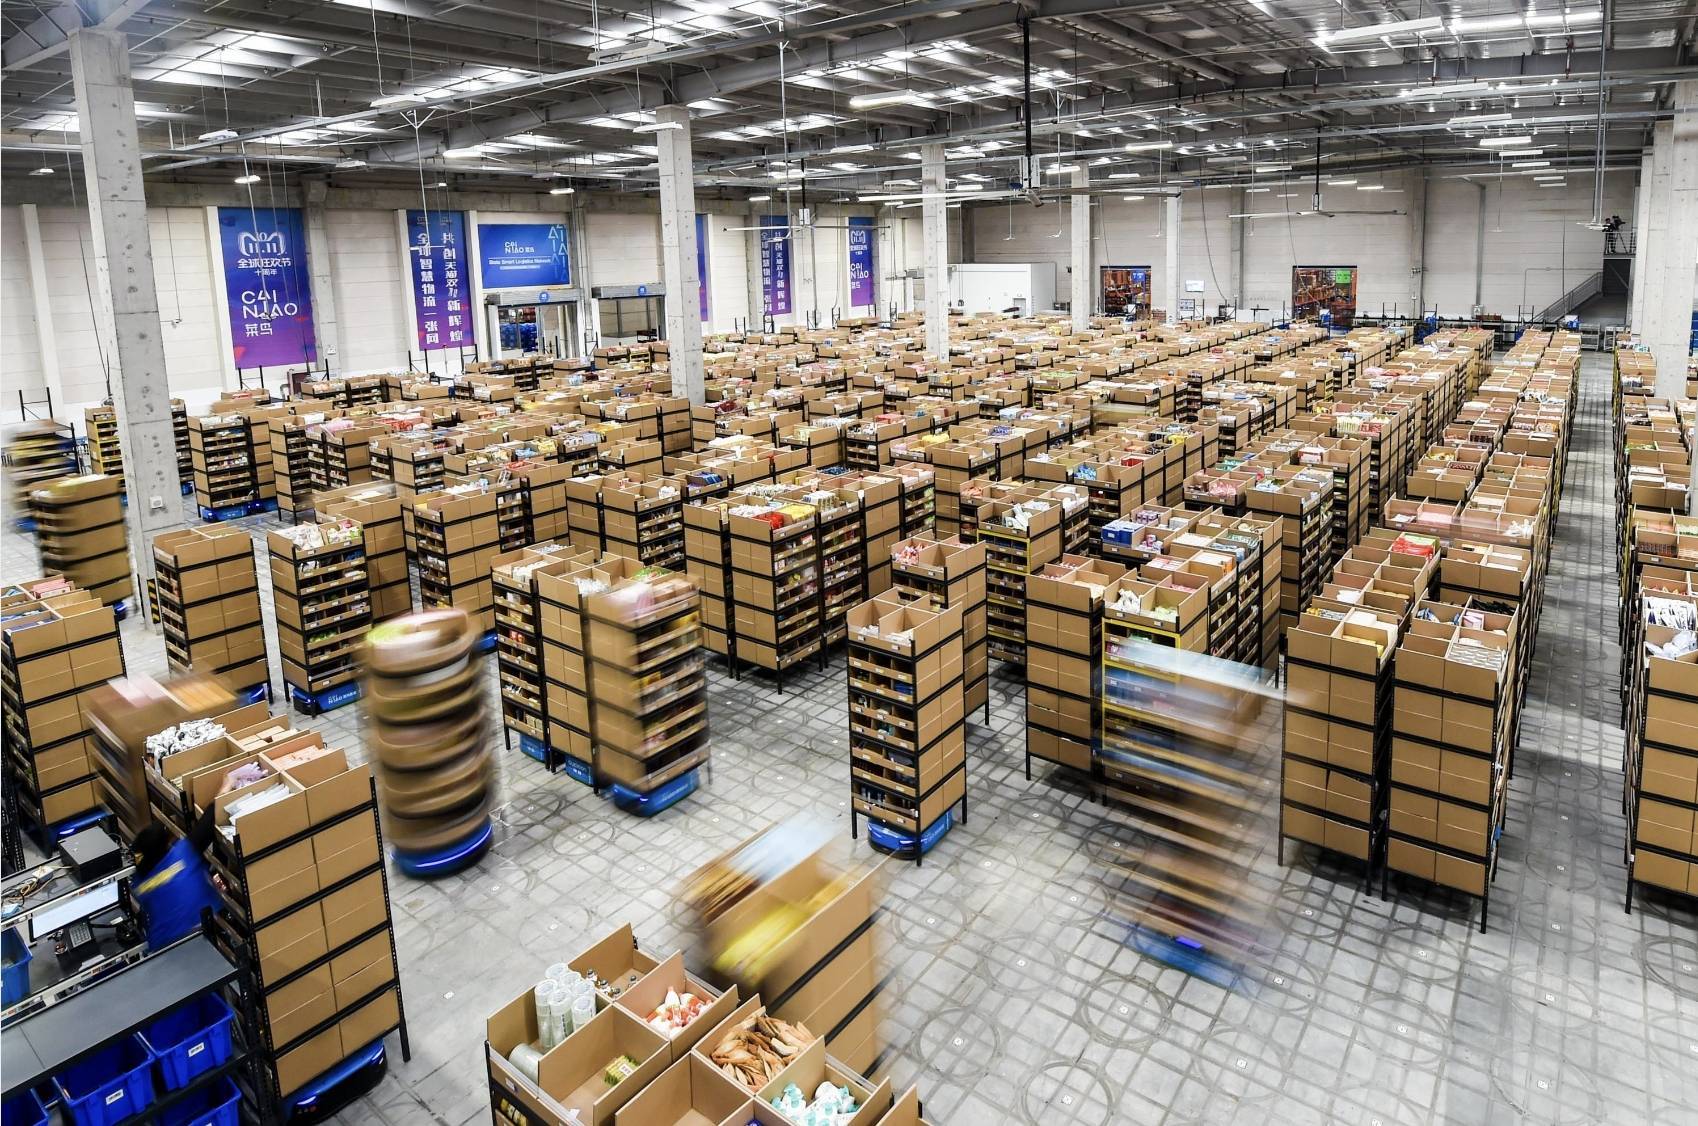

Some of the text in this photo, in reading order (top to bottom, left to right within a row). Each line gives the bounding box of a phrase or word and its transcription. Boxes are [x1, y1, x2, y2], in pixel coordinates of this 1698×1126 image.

[237, 257, 291, 269] 全球狂欢节
[850, 262, 863, 271] CAI
[851, 270, 869, 280] NIAO
[241, 289, 278, 305] CAI
[242, 301, 298, 319] NIAO
[244, 322, 273, 338] 菜鸟
